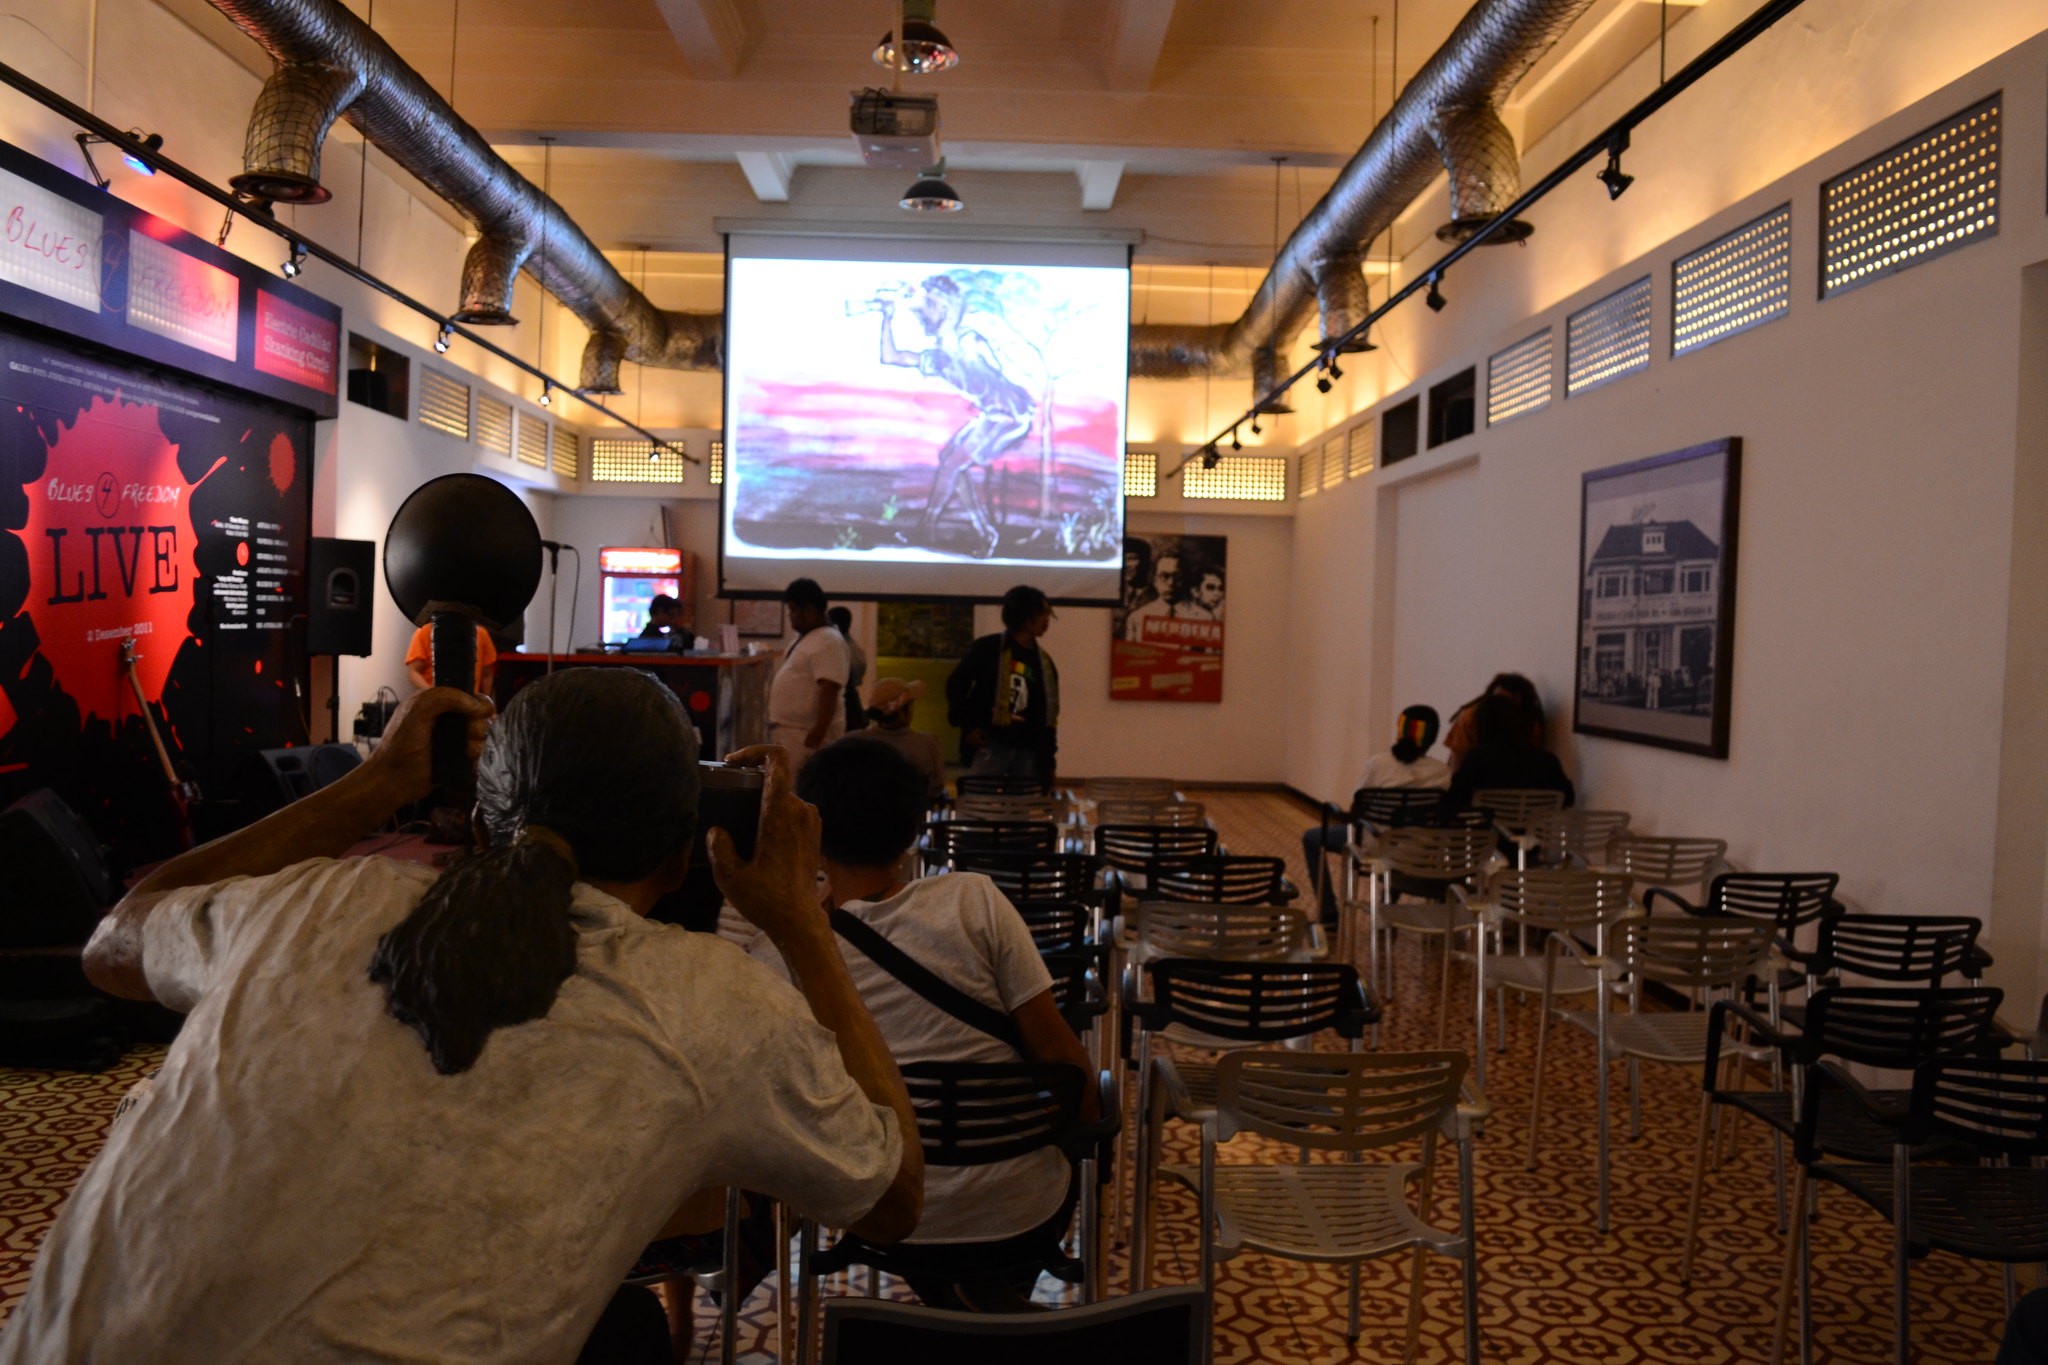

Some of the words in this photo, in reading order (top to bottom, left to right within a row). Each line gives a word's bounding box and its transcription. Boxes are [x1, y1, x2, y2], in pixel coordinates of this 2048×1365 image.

[6, 205, 88, 269] BLUES
[47, 478, 95, 502] BLUES
[120, 483, 181, 507] FREEDOM
[46, 525, 178, 606] LIVE
[134, 621, 153, 636] 2011
